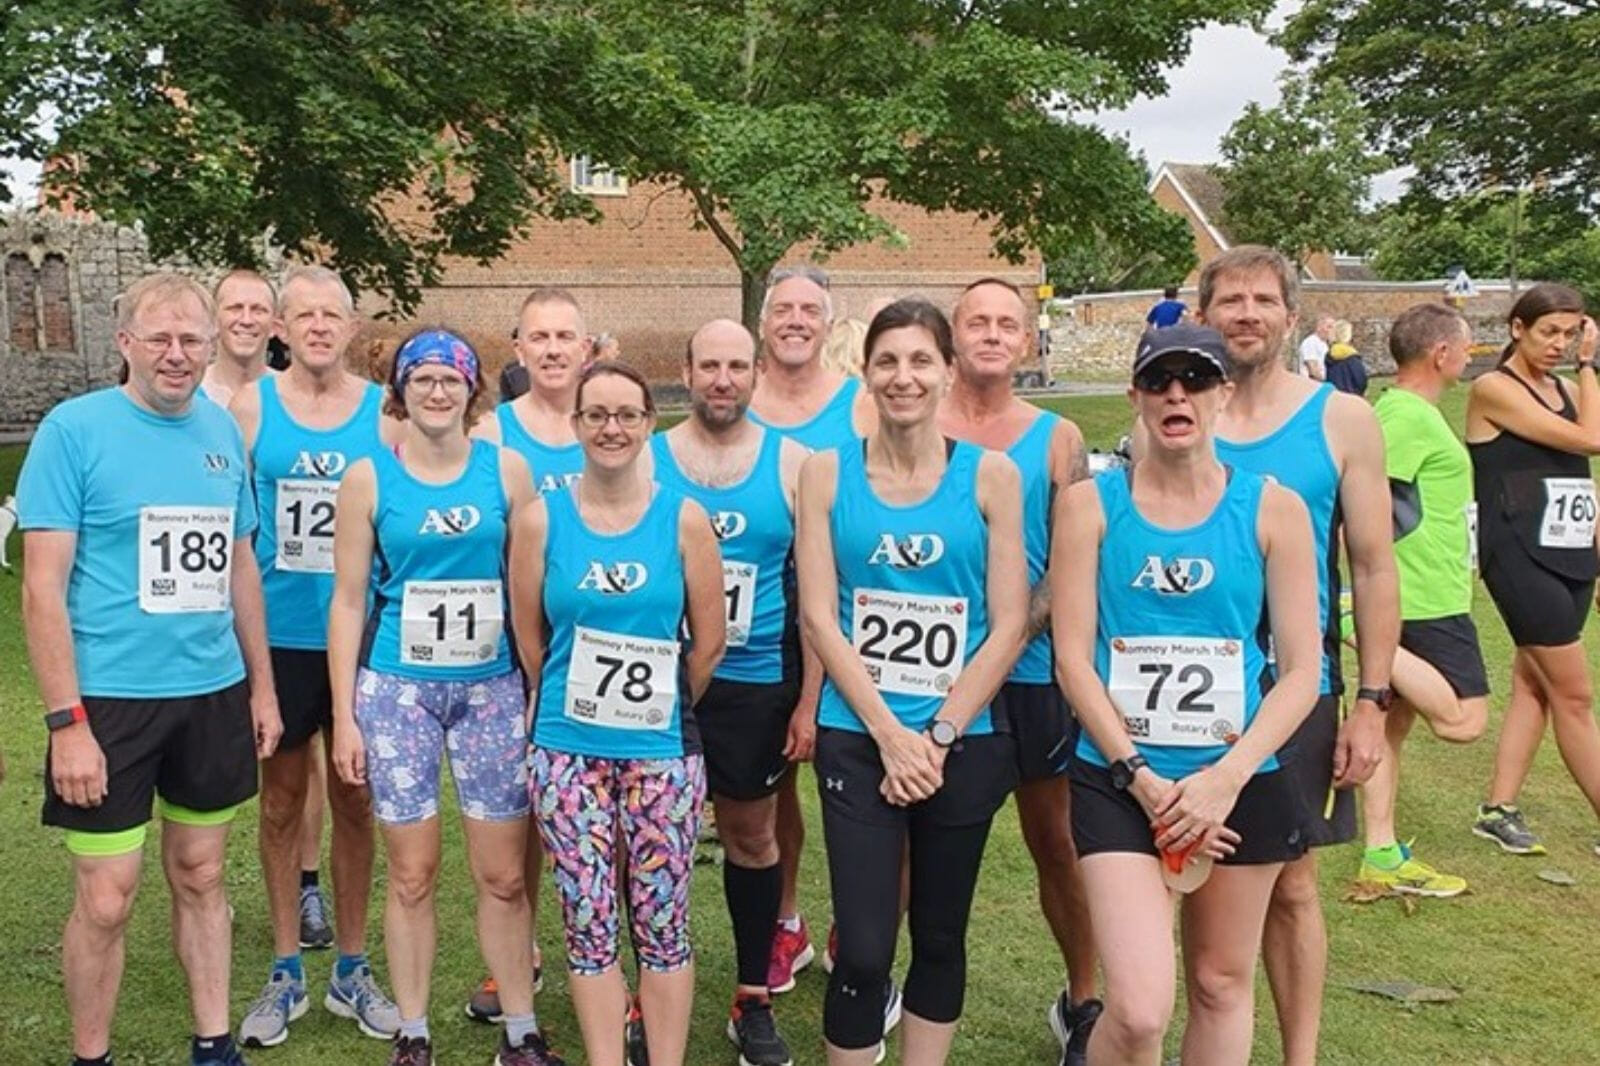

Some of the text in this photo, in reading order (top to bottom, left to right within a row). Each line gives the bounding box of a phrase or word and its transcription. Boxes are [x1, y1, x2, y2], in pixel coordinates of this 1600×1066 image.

[419, 504, 480, 538] A&D
[1555, 494, 1596, 521] 160
[151, 531, 227, 573] 183
[868, 533, 944, 571] A&D
[577, 560, 647, 594] A&D
[1131, 555, 1214, 595] A&D
[428, 602, 475, 641] 11
[907, 601, 942, 613] Marsh
[581, 633, 621, 651] Romney
[624, 641, 655, 654] Marsh
[859, 613, 957, 668] 220
[1125, 643, 1168, 655] omney
[1171, 643, 1211, 656] Marsh
[595, 655, 653, 703] 78
[900, 673, 932, 687] Rotary
[1139, 664, 1215, 712] 72
[614, 707, 644, 721] Rotary
[1171, 721, 1208, 735] Rotary
